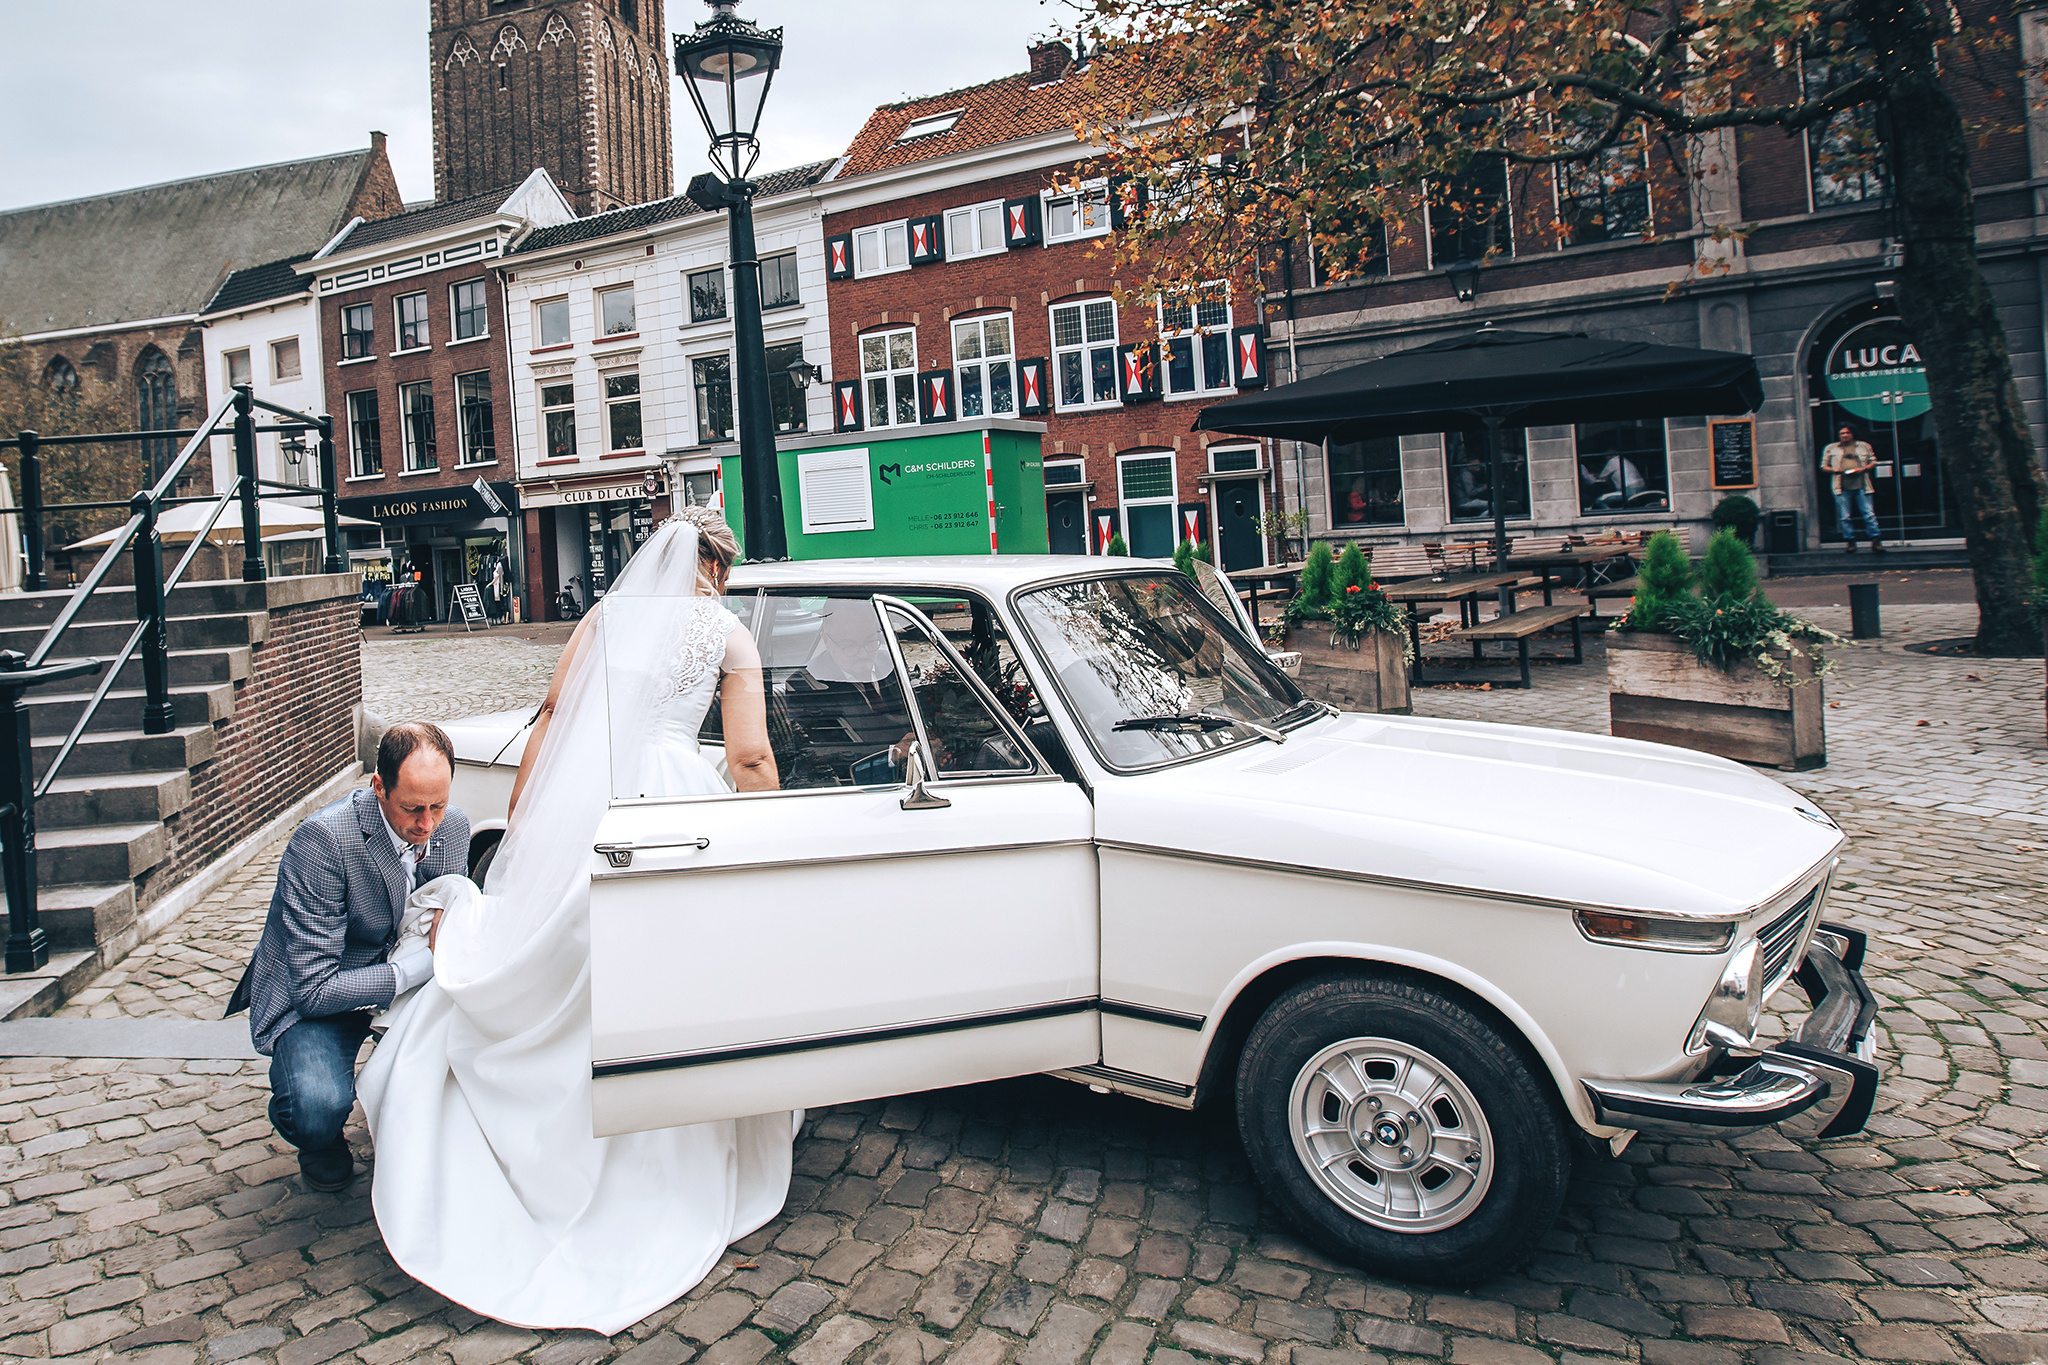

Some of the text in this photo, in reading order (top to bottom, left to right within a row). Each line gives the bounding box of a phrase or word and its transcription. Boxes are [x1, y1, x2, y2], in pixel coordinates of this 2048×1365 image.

[1845, 343, 1922, 369] LUCA
[1831, 366, 1914, 380] DRINKWINKEL
[904, 459, 976, 473] C&M SCHILDERS
[926, 470, 976, 479] CM-SCHILDERS.COM
[564, 486, 645, 502] CLUB DI CAFF
[372, 498, 468, 518] LAGOS FASHION
[907, 514, 930, 522] MELLE
[933, 513, 942, 521] 06
[908, 523, 929, 531] CHRIS
